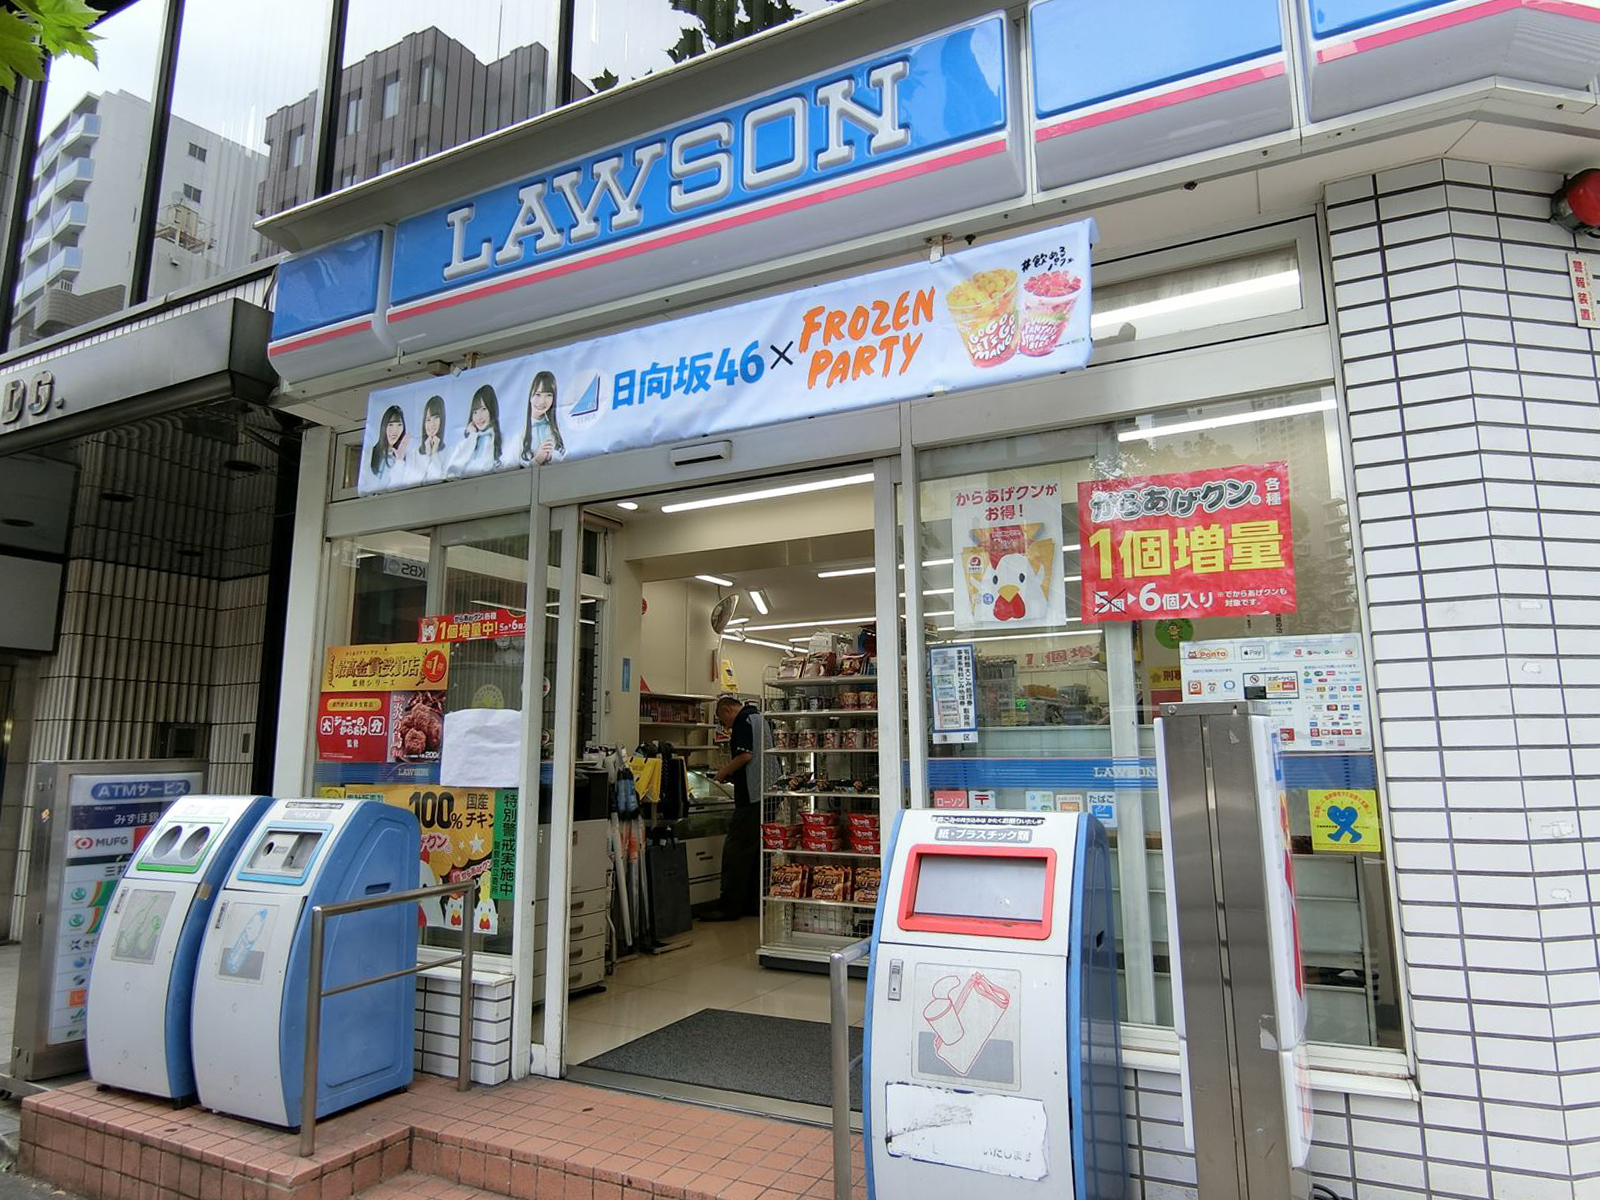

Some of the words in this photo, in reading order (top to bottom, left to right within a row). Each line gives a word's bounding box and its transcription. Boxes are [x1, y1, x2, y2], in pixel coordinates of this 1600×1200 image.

[442, 60, 910, 282] LAWSON
[1572, 260, 1591, 321] 警報装置
[799, 286, 936, 353] FROZEN
[808, 332, 924, 389] PARTY
[612, 340, 765, 411] 日向坂46
[955, 483, 1058, 507] からあげクンが
[1264, 477, 1282, 506] 各種
[985, 504, 1023, 521] お得!
[1088, 520, 1286, 580] 1個増量
[440, 621, 498, 639] 1個増量中!
[1200, 650, 1227, 658] Ponta
[98, 783, 188, 797] ATMサービス
[466, 793, 489, 810] 国産
[937, 797, 966, 807] ローソン
[1089, 794, 1115, 804] たばこ
[409, 791, 463, 829] 100%
[96, 837, 128, 847] MUFG
[500, 794, 518, 896] 特別警戒実施中
[938, 829, 1030, 841] 紙・プラスチック類
